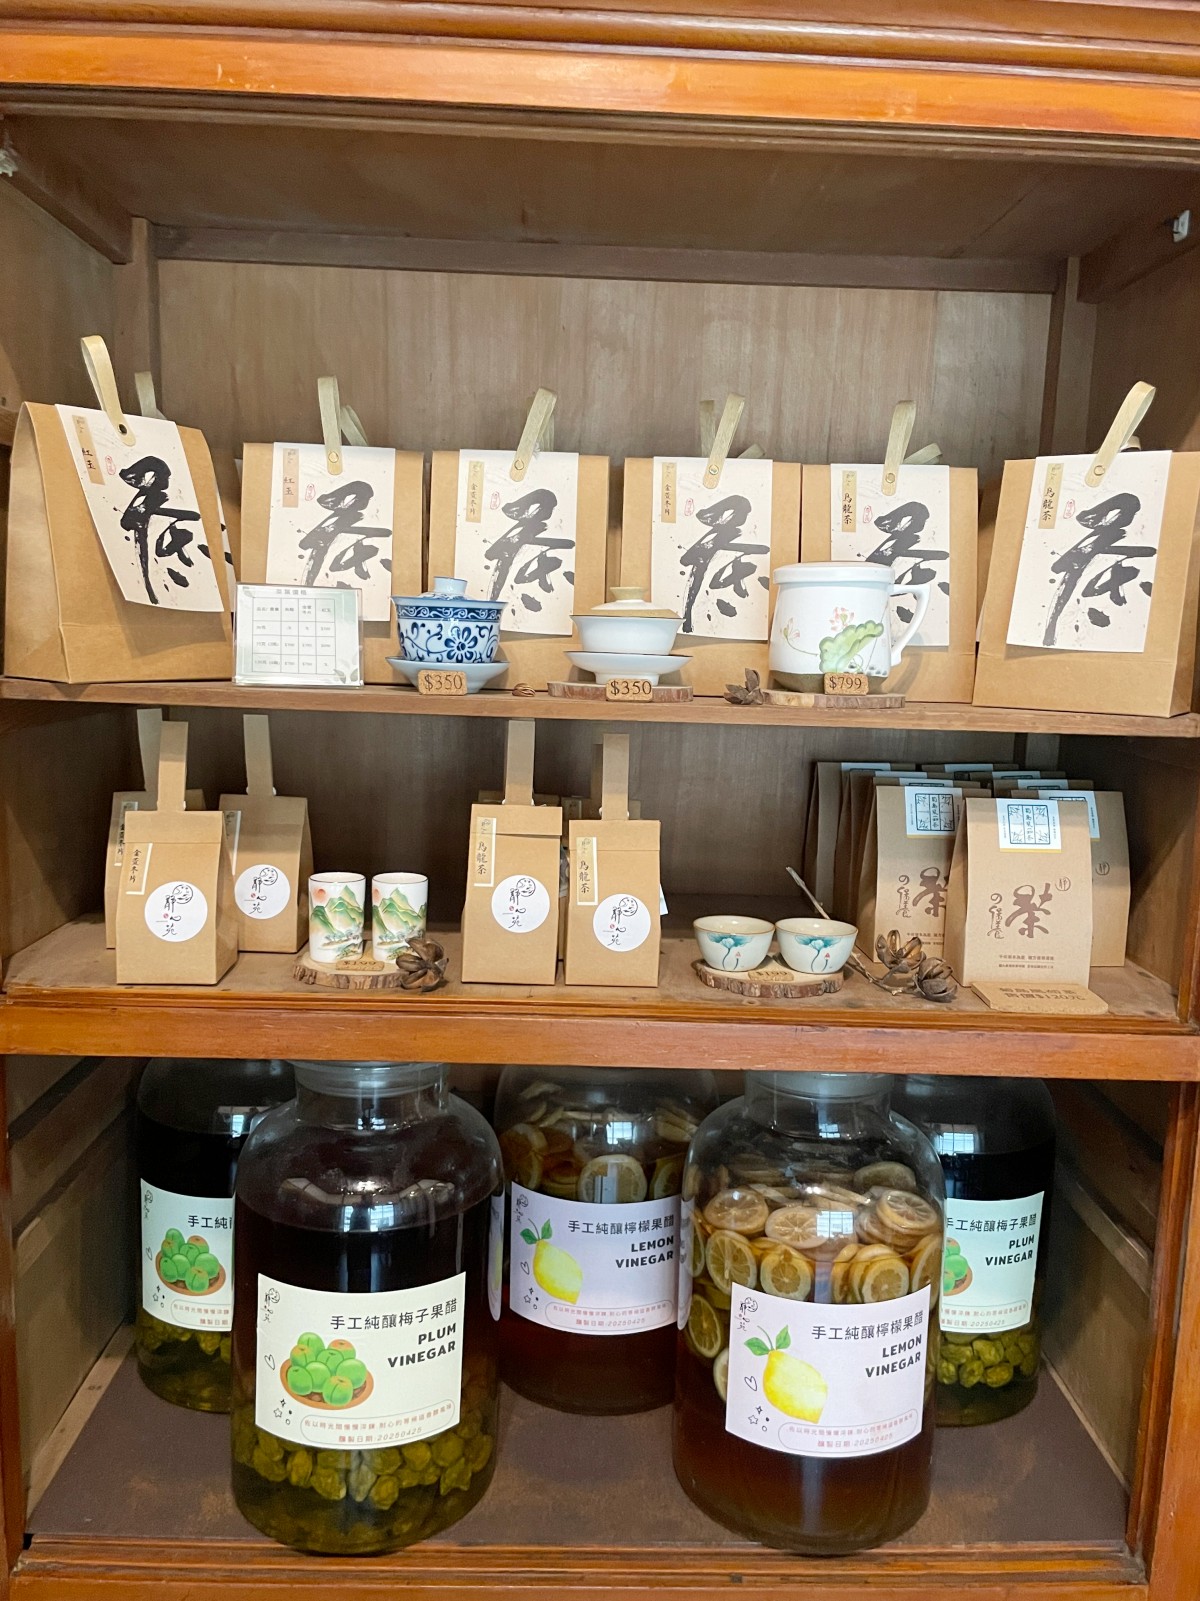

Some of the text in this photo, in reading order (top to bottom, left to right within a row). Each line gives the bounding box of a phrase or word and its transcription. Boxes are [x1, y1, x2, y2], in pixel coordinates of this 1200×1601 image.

[842, 492, 853, 525] 烏龍茶
[1042, 486, 1055, 521] 烏龍茶
[425, 674, 462, 691] $350
[611, 680, 651, 696] $350
[830, 676, 862, 690] $799
[477, 841, 487, 875] 烏龍茶
[579, 860, 590, 894] 烏龍茶
[188, 1215, 232, 1229] 手工純
[568, 1215, 674, 1235] 手工純釀檸檬果醋
[631, 1235, 674, 1253] LEMON
[1009, 1234, 1034, 1250] PLUM
[616, 1250, 673, 1268] VINEGAR
[985, 1249, 1033, 1266] VINEGAR
[330, 1298, 457, 1330] 手工純釀梅子果醋
[812, 1310, 923, 1340] 手工純釀檸檬果醋
[418, 1323, 456, 1345] PLUM
[387, 1341, 456, 1368] VINEGAR
[882, 1335, 922, 1358] LEMON
[865, 1351, 921, 1378] VINEGAR
